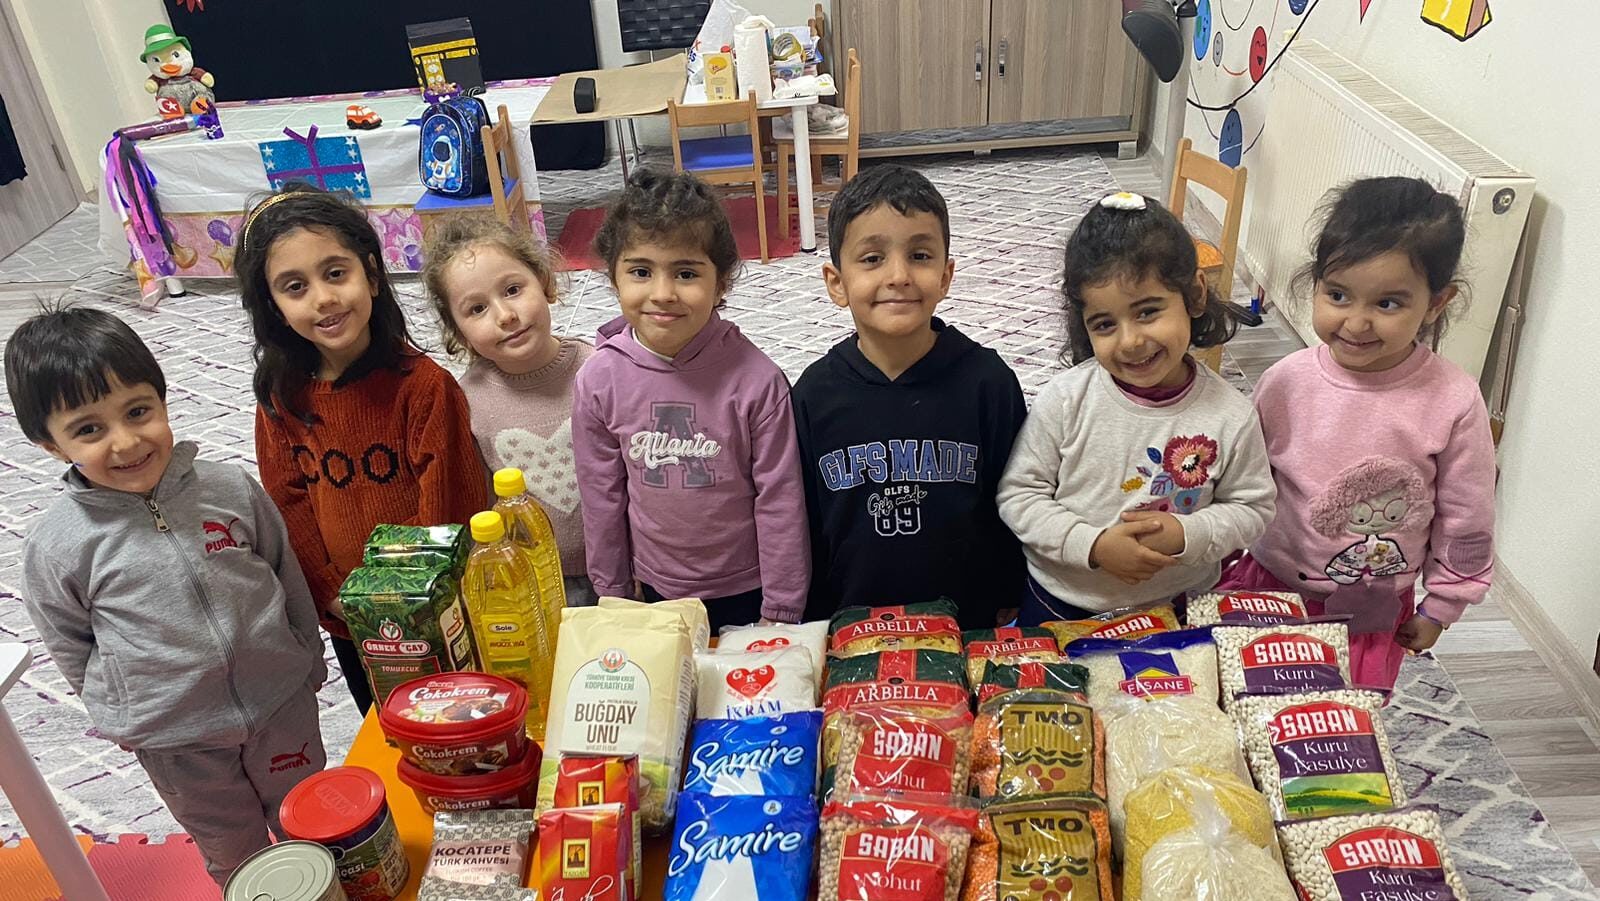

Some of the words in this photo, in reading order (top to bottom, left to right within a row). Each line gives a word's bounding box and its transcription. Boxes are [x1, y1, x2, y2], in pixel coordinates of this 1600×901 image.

[629, 431, 722, 469] Atlanta
[818, 441, 888, 491] GLFS
[889, 440, 979, 484] MADE
[884, 485, 910, 496] GLFS
[874, 505, 921, 537] 89
[205, 538, 236, 554] PUMA
[1228, 596, 1293, 615] SABAN
[852, 620, 928, 636] ARBELLA
[983, 641, 1042, 655] ARBELLA
[1254, 641, 1325, 665] SABAN
[1273, 668, 1315, 681] Kuru
[854, 685, 939, 704] ARBELLA
[574, 699, 638, 724] BUĞDAY
[1010, 710, 1084, 726] TMO
[1280, 708, 1359, 738] SABAN
[587, 724, 620, 744] UNU
[873, 729, 942, 761] SABAN
[1303, 740, 1349, 756] Kuru
[683, 739, 805, 790] Samire
[872, 770, 926, 790] Nohut
[1003, 817, 1084, 836] TMO
[434, 845, 512, 857] KOCATEPE
[668, 822, 803, 878] Samire
[857, 832, 935, 863] SABAN
[1338, 837, 1424, 867] SABAN
[862, 871, 922, 892] Nohut
[1368, 869, 1415, 887] Kuru
